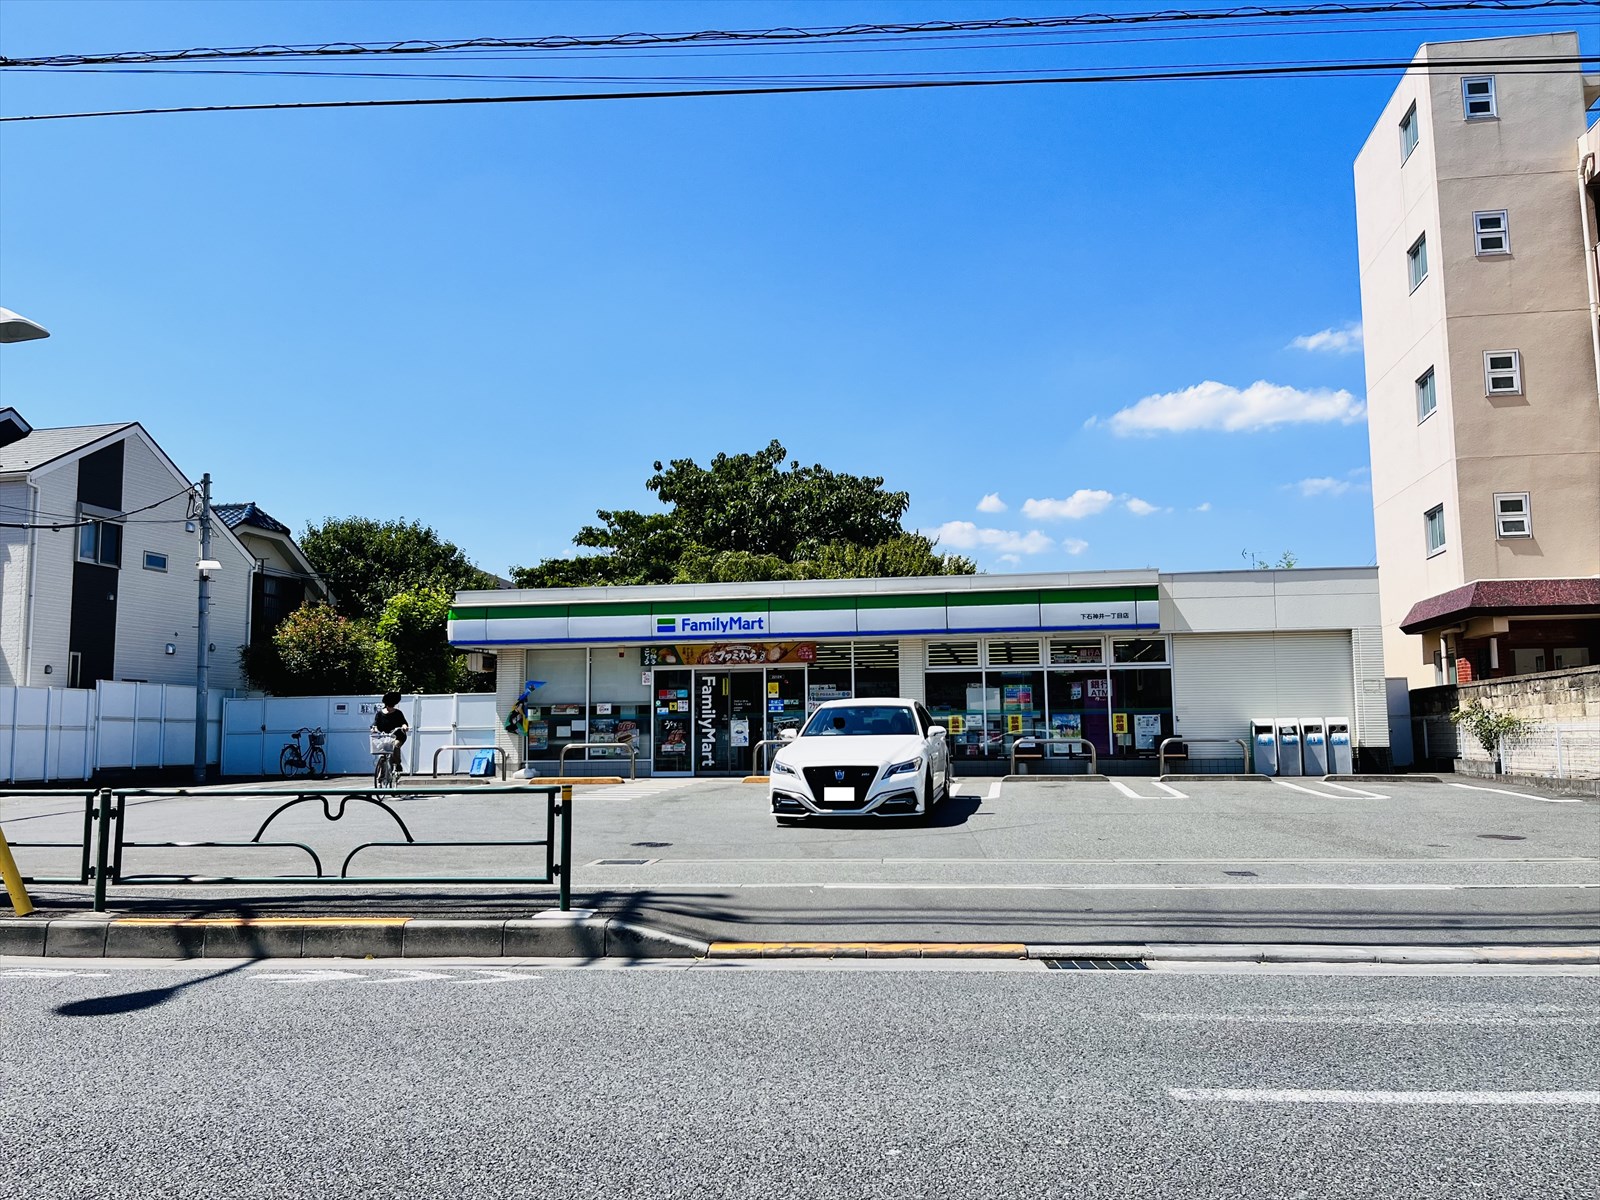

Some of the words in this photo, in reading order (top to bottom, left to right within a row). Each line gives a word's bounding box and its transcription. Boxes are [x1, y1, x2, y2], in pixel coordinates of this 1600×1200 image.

[1080, 612, 1130, 620] 下石神井一丁目店
[681, 616, 764, 633] FamilyMart
[1090, 680, 1109, 689] 銀行
[1090, 689, 1109, 697] ATM
[698, 676, 716, 766] FamilyMart
[1115, 715, 1125, 732] 禁煙
